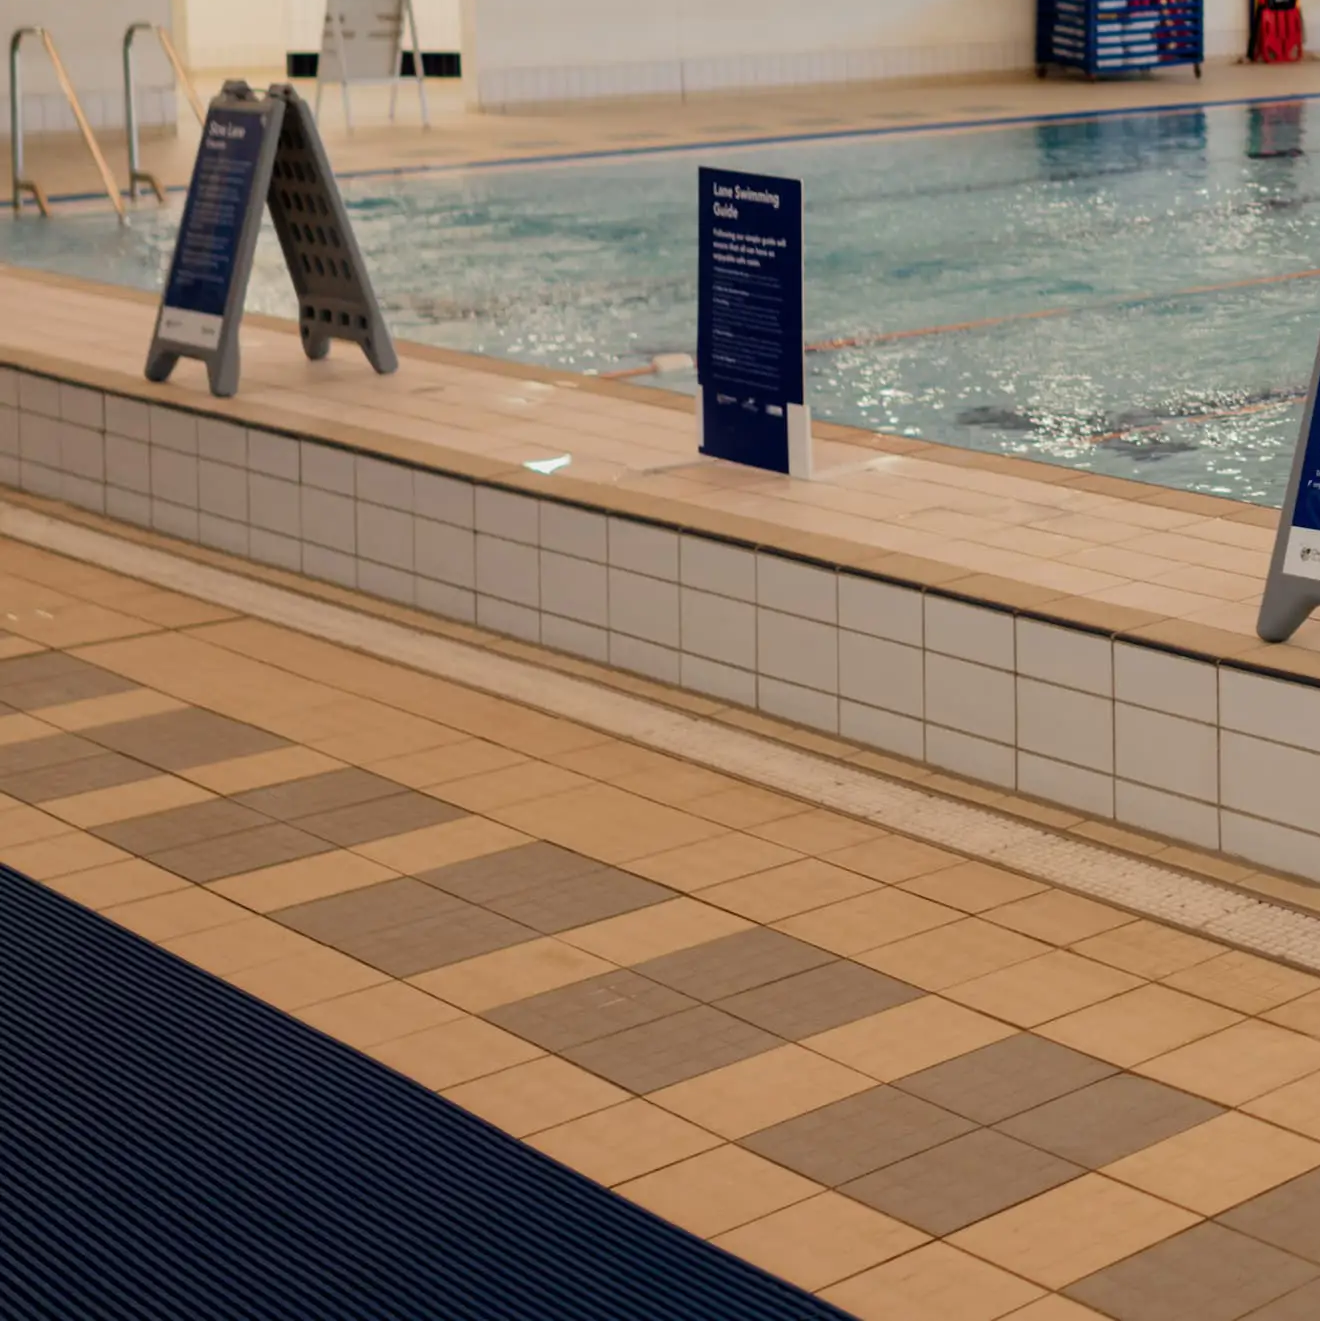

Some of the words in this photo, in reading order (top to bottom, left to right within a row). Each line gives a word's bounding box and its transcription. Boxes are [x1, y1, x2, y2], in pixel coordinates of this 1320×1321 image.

[713, 181, 733, 198] Lane
[734, 184, 780, 209] Swimming
[713, 201, 739, 220] Guide
